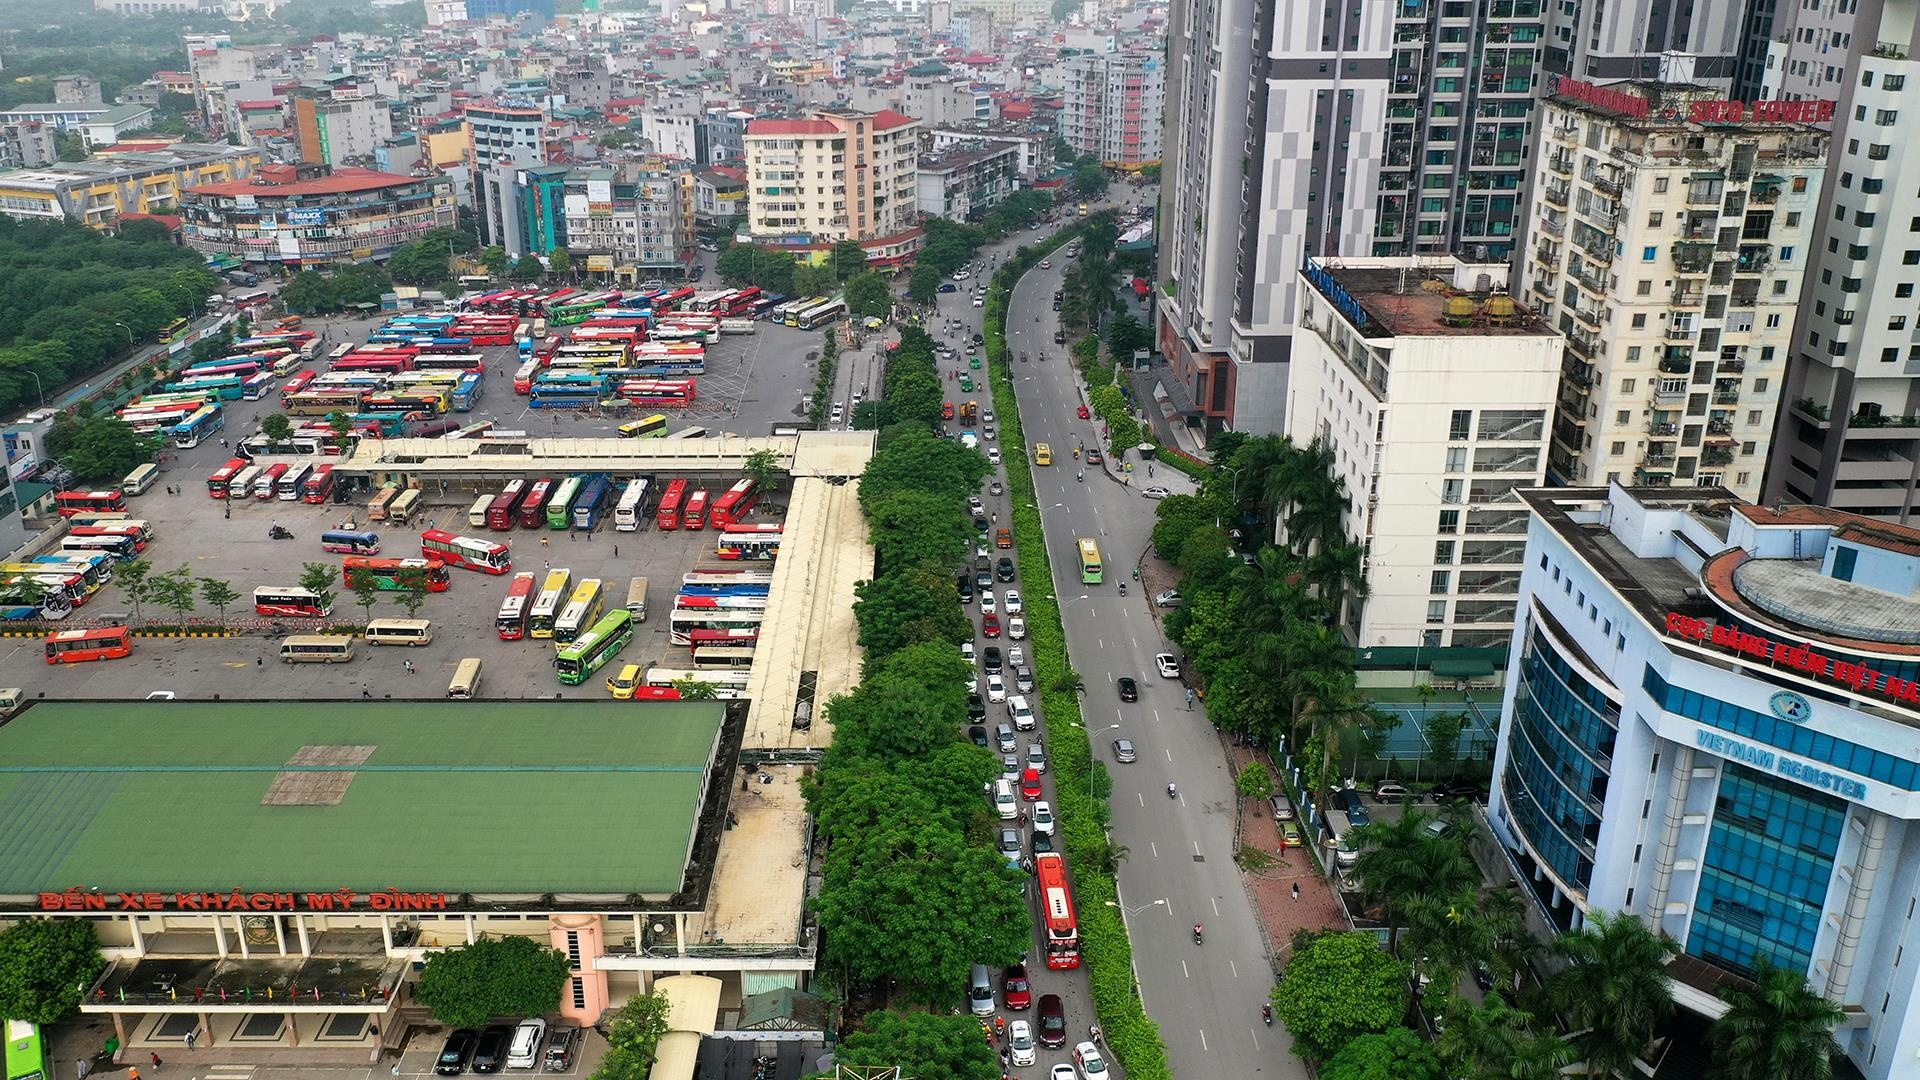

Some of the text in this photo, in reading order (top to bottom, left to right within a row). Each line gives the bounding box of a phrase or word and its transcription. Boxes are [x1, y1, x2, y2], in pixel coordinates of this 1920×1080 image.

[1689, 99, 1835, 122] SICO TOWER
[1665, 612, 1920, 705] CỤC ĐĂNG KIỂM VIỆT NA
[1696, 728, 1868, 801] VIETNAM REGISTER
[39, 886, 447, 911] BẾN XE KHÁCH MỸ ĐÌNH
